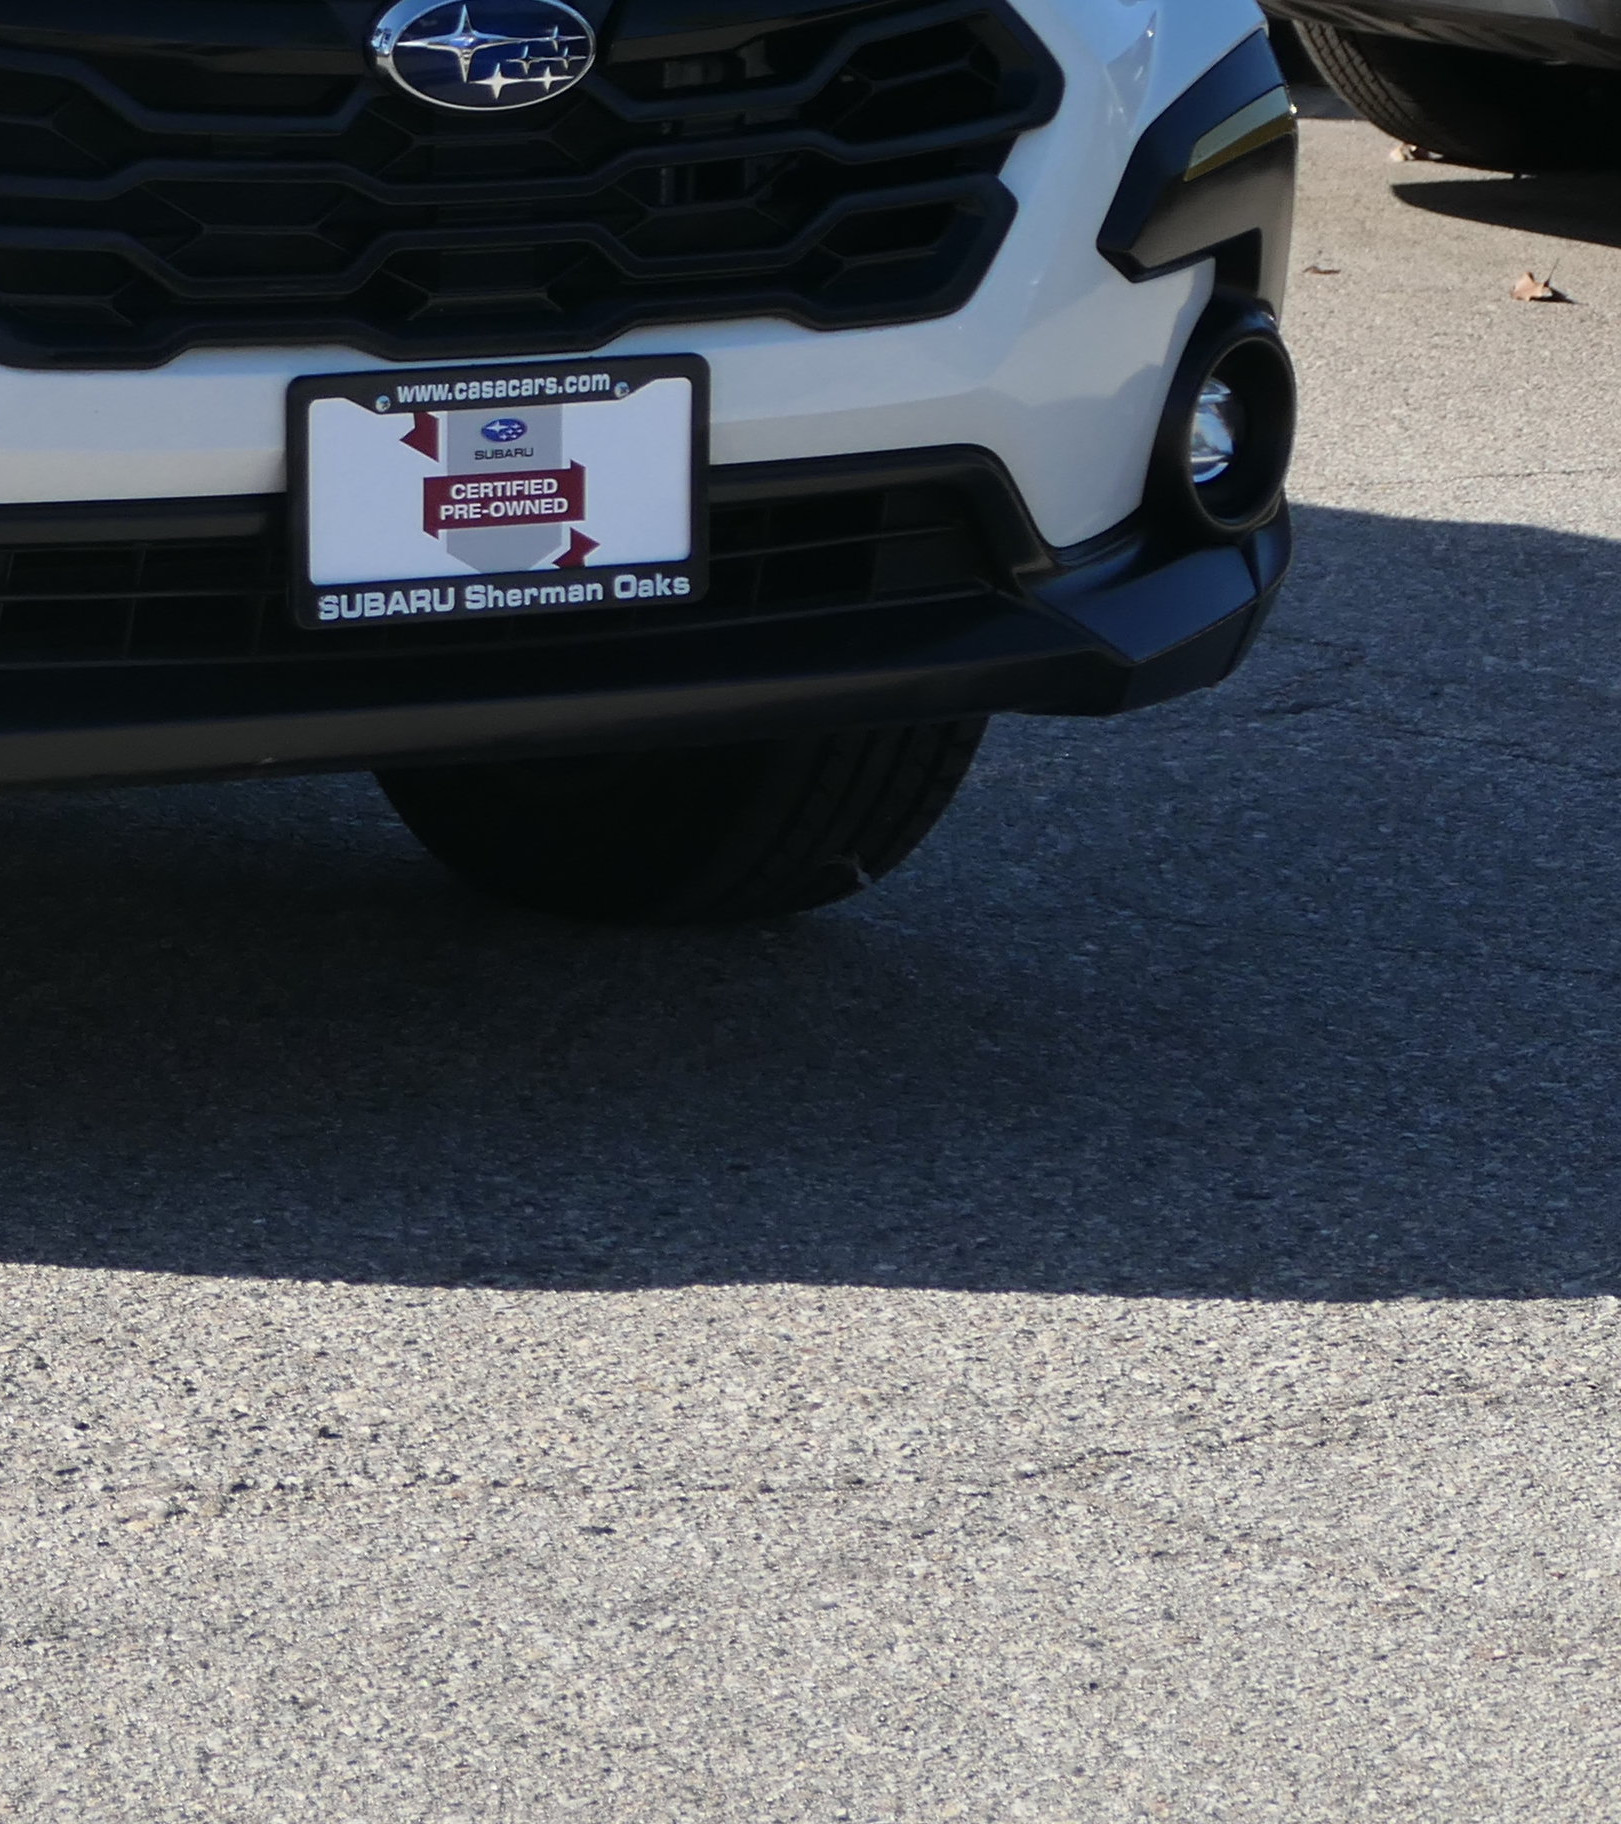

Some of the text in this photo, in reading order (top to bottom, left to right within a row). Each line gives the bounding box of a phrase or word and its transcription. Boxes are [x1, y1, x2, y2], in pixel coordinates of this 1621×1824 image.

[397, 373, 610, 403] www.casacars.com
[474, 447, 534, 460] SUBARU
[450, 478, 558, 500] CERTIFIED
[439, 497, 569, 521] PRE-OWNED
[318, 574, 691, 621] SUBARU Sherman Oaks
